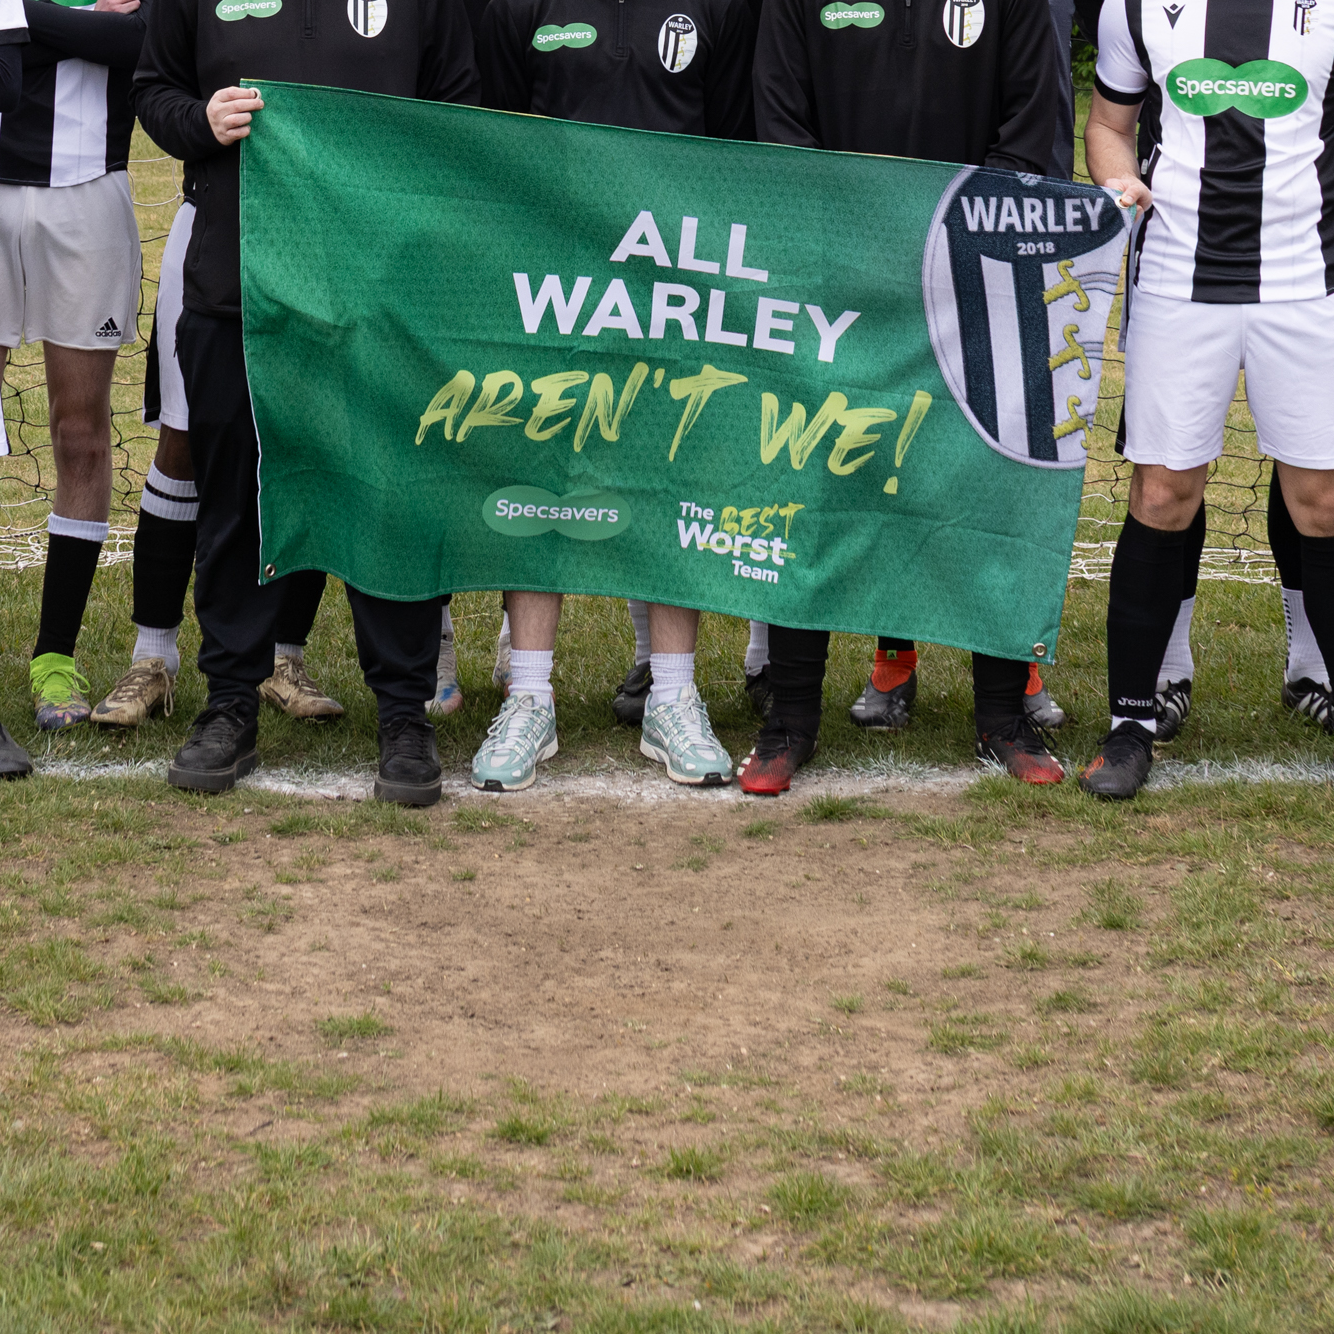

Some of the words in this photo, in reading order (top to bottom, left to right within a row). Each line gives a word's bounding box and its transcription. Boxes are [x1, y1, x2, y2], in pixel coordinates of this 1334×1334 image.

[221, 1, 276, 14] Specsavers
[825, 10, 879, 21] Specsavers
[668, 21, 692, 30] WARLEY
[537, 31, 591, 44] Specsavers
[1176, 77, 1296, 98] Specsavers
[960, 196, 1104, 233] WARLEY
[609, 210, 768, 282] ALL
[1017, 242, 1055, 255] 2018
[513, 272, 861, 363] WARLEY
[95, 329, 121, 337] adidas
[416, 361, 748, 462] AREN'T
[760, 390, 932, 494] WE!
[495, 499, 619, 523] Specsavers
[679, 502, 714, 520] The
[719, 502, 805, 539] BEST
[677, 519, 787, 566] Worst
[731, 560, 778, 583] Team
